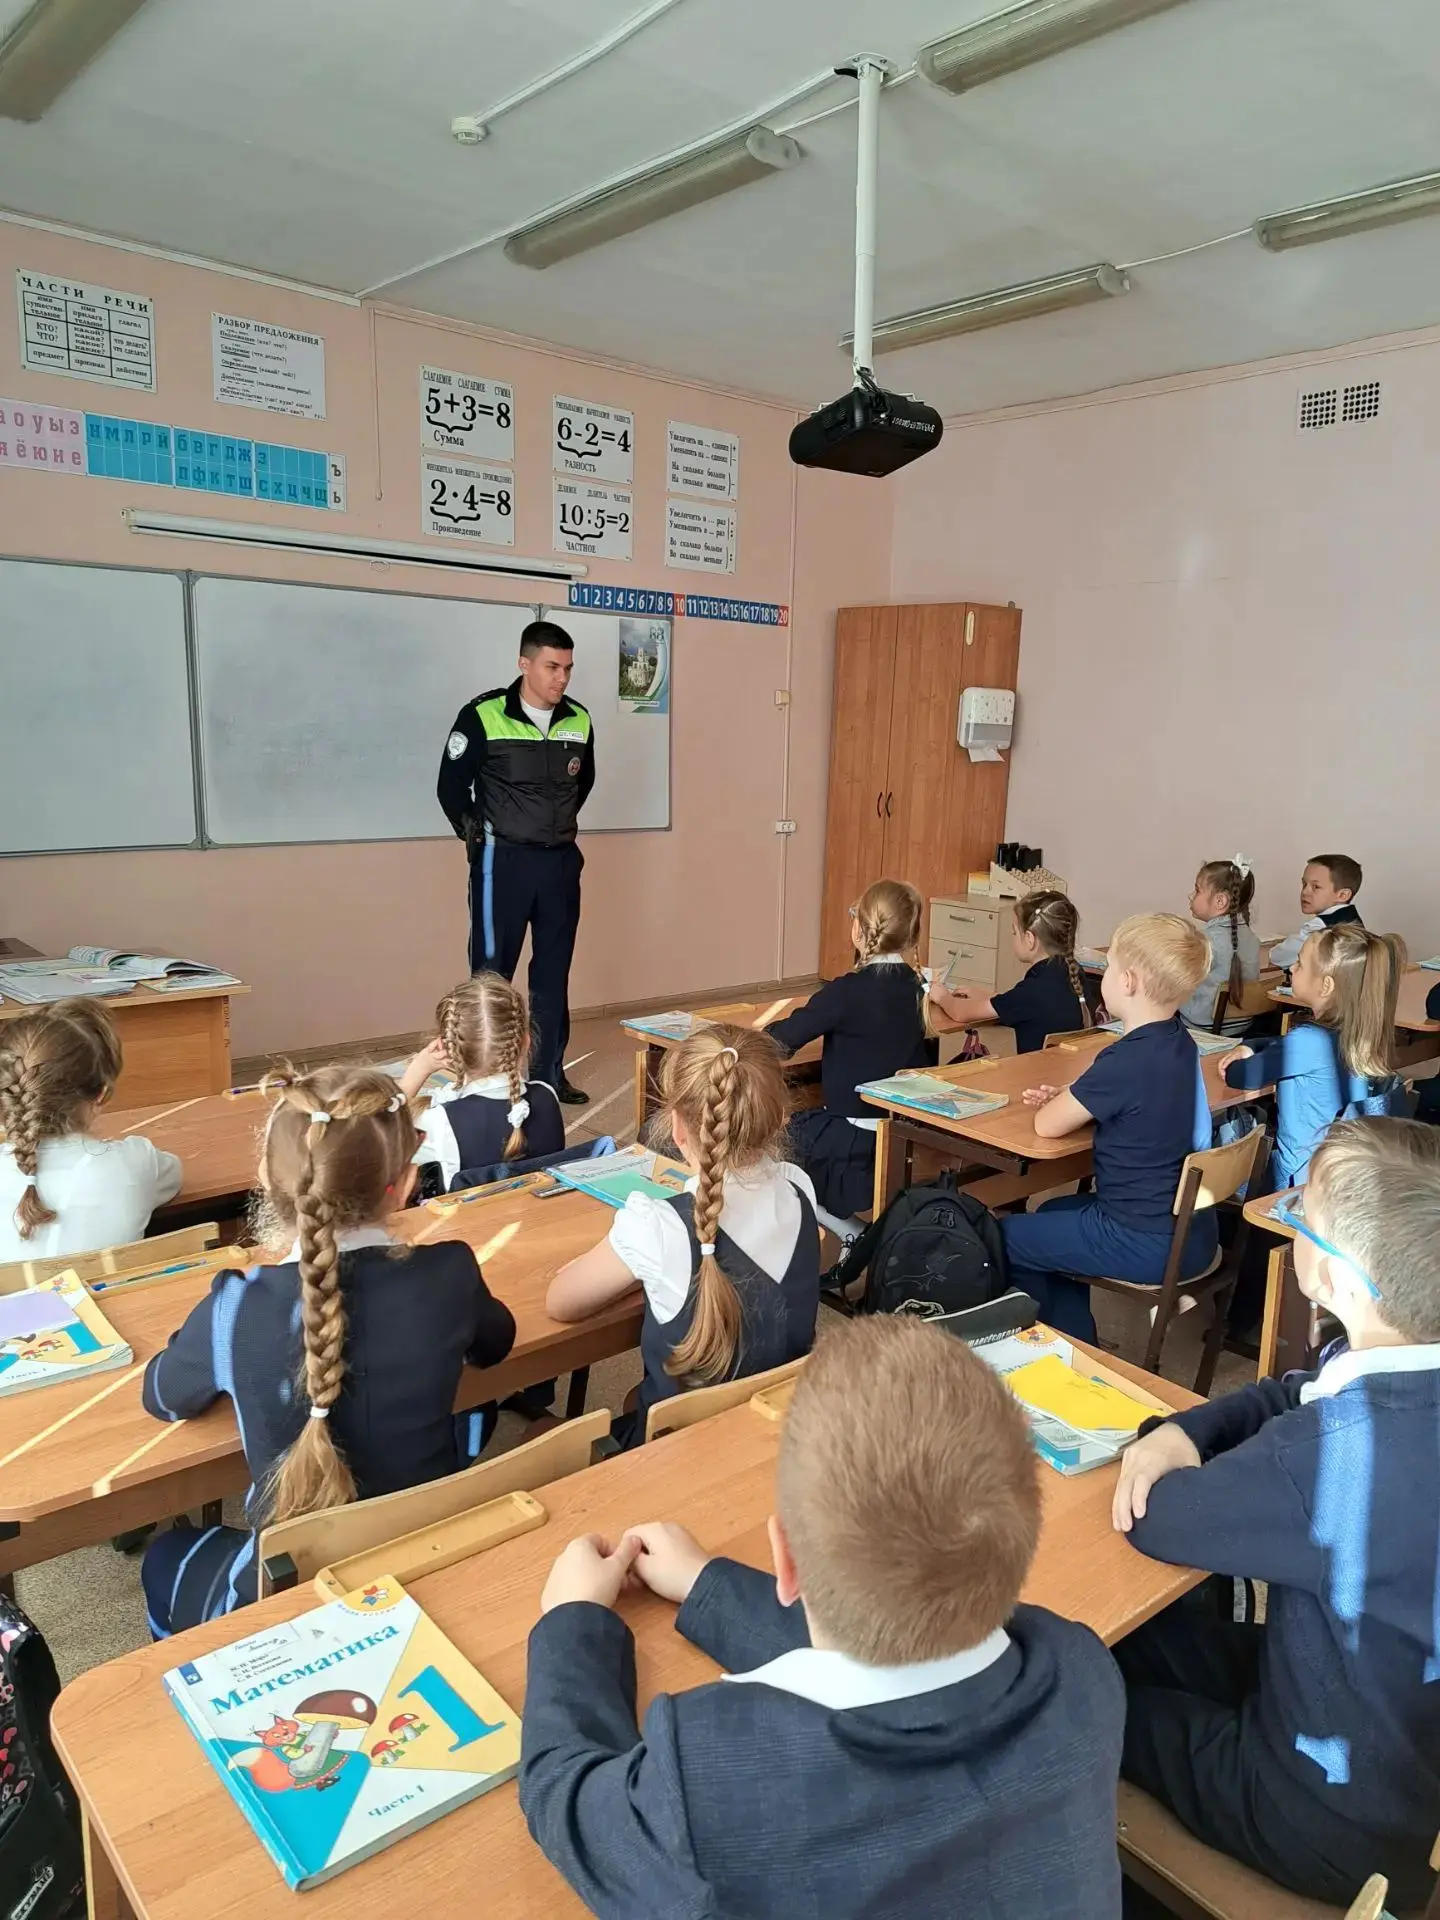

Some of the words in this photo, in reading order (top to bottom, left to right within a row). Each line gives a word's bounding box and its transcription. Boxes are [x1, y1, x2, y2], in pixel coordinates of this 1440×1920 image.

[22, 277, 84, 298] ЧАСТИ
[104, 295, 148, 312] РЕЧИ
[36, 322, 58, 334] КТО?
[37, 331, 58, 341] ЧТО?
[219, 317, 250, 329] РАЗБОР
[254, 325, 319, 345] ПРЕДЛОЖЕНИЯ
[126, 340, 147, 349] делать?
[426, 388, 511, 428] 5+3=8
[14, 412, 24, 427] о
[32, 415, 43, 434] у
[49, 417, 63, 433] ы
[70, 421, 79, 435] э
[89, 423, 100, 439] н
[106, 427, 119, 441] м
[124, 428, 134, 443] л
[141, 431, 151, 445] р
[158, 430, 168, 449] й
[178, 434, 188, 451] б
[192, 440, 203, 454] в
[209, 443, 218, 456] г
[225, 446, 236, 462] д
[238, 448, 252, 462] ж
[258, 452, 267, 464] з
[434, 430, 464, 446] Сумма
[558, 417, 631, 452] 6-2=4
[16, 439, 27, 458] ё
[33, 446, 47, 461] ю
[53, 448, 64, 463] и
[72, 451, 82, 465] е
[178, 467, 188, 480] п
[192, 467, 206, 485] ф
[209, 471, 219, 485] к
[226, 475, 236, 487] т
[238, 476, 252, 490] ш
[259, 479, 268, 492] с
[273, 482, 282, 494] х
[288, 484, 297, 499] ц
[302, 486, 311, 498] ч
[315, 488, 327, 505] щ
[565, 459, 596, 472] РАЗНОСТЬ
[432, 521, 481, 537] Произведение
[560, 503, 629, 533] 10:5=2
[566, 541, 596, 553] ЧАСТНОЕ
[571, 587, 577, 602] 0
[583, 588, 589, 604] 1
[594, 589, 601, 605] 2
[605, 590, 612, 606] 3
[616, 592, 624, 607] 4
[628, 593, 634, 608] 5
[638, 594, 645, 610] 6
[648, 595, 655, 611] 7
[658, 596, 664, 611] 8
[667, 597, 673, 612] 9
[676, 598, 685, 613] 10
[688, 600, 697, 614] 11
[699, 600, 709, 615] 12
[710, 601, 719, 616] 13
[720, 602, 729, 617] 14
[730, 603, 739, 618] 15
[740, 604, 748, 619] 16
[751, 605, 760, 620] 17
[760, 606, 769, 621] 18
[770, 608, 778, 623] 19
[779, 609, 788, 625] 20
[208, 1623, 400, 1715] Математика
[397, 1665, 506, 1753] 1
[368, 1795, 414, 1816] Часть
